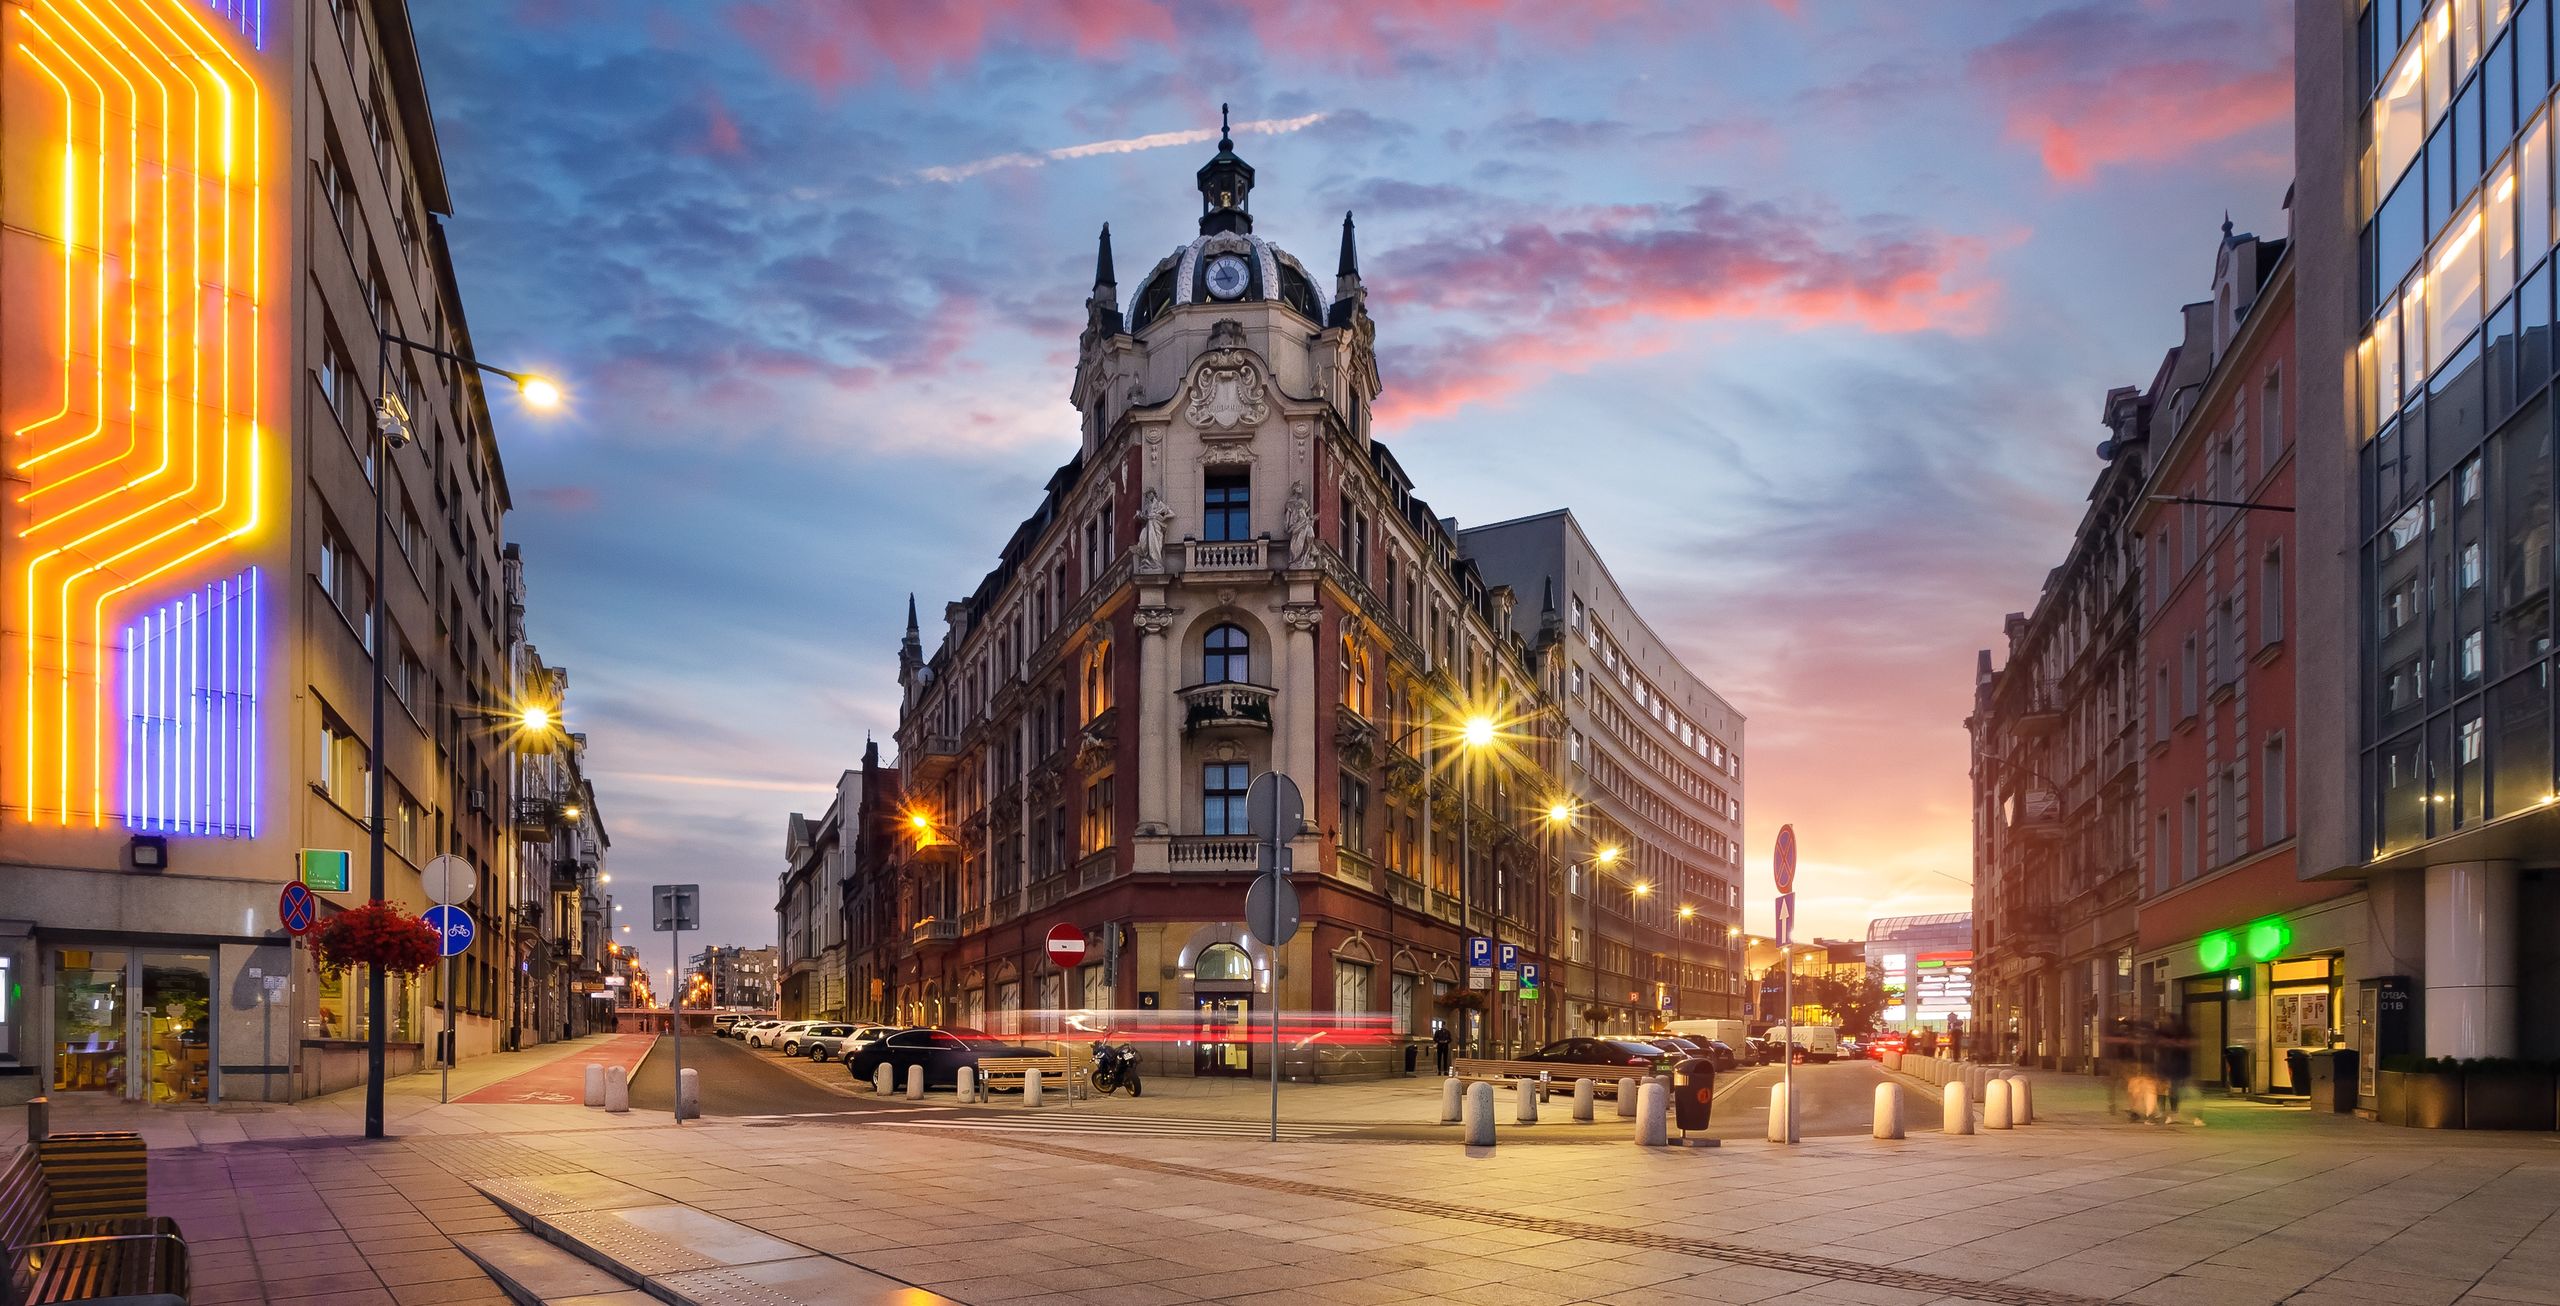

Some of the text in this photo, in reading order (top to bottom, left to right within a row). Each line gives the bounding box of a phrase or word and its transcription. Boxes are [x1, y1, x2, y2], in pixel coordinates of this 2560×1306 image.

[1474, 940, 1488, 959] P
[1503, 946, 1514, 963] P
[1524, 965, 1535, 981] P
[1663, 997, 1671, 1006] P
